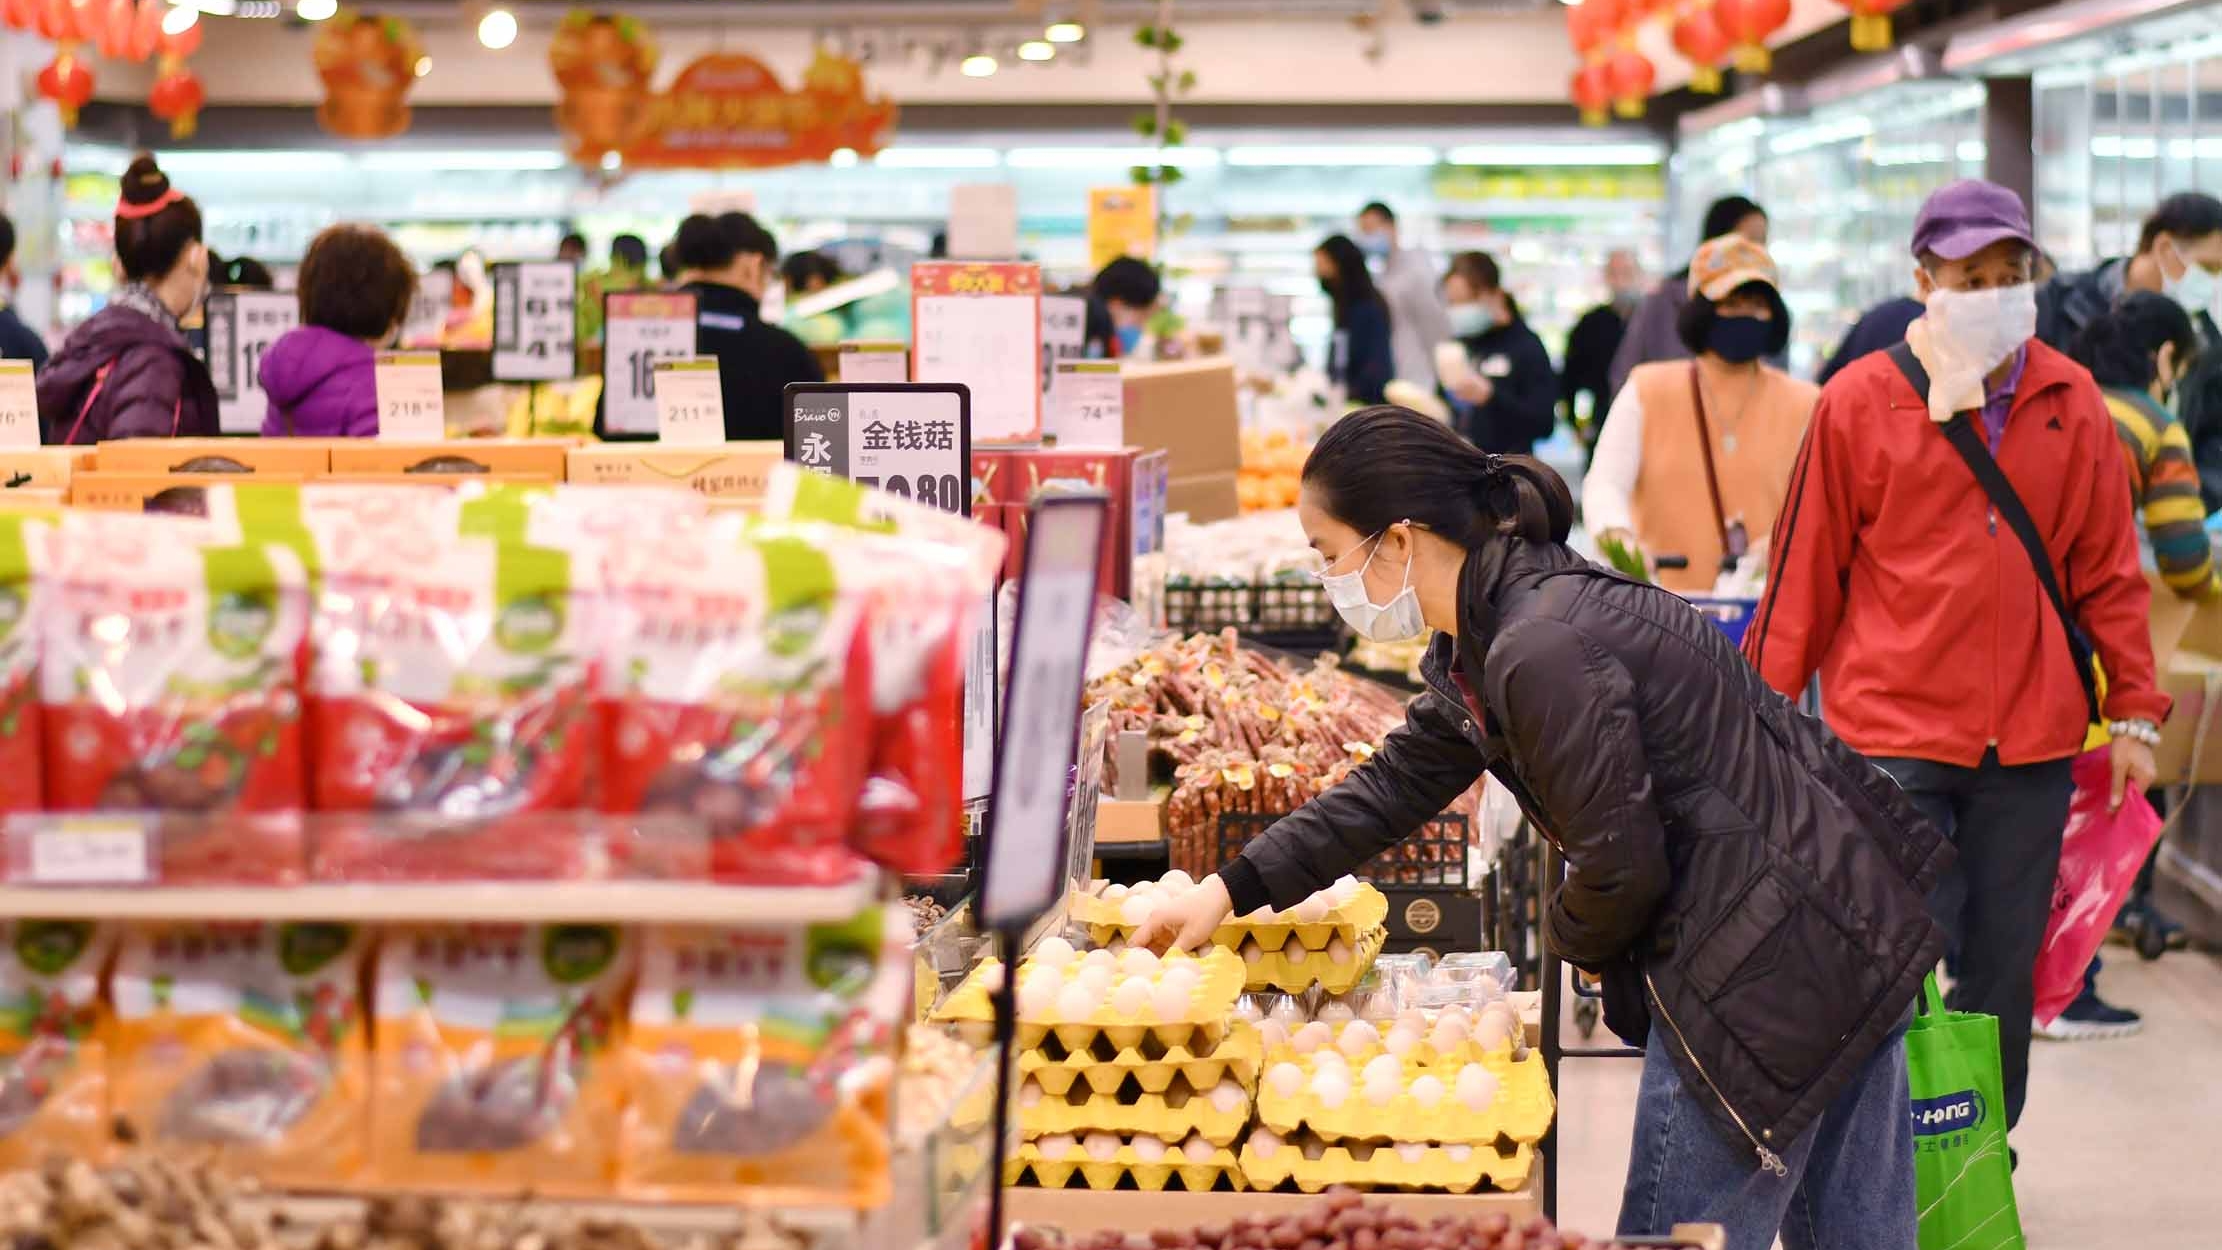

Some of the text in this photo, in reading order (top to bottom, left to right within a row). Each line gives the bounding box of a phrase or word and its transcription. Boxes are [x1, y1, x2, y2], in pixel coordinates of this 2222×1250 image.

[794, 408, 826, 423] Bravo
[862, 420, 954, 450] 金钱菇
